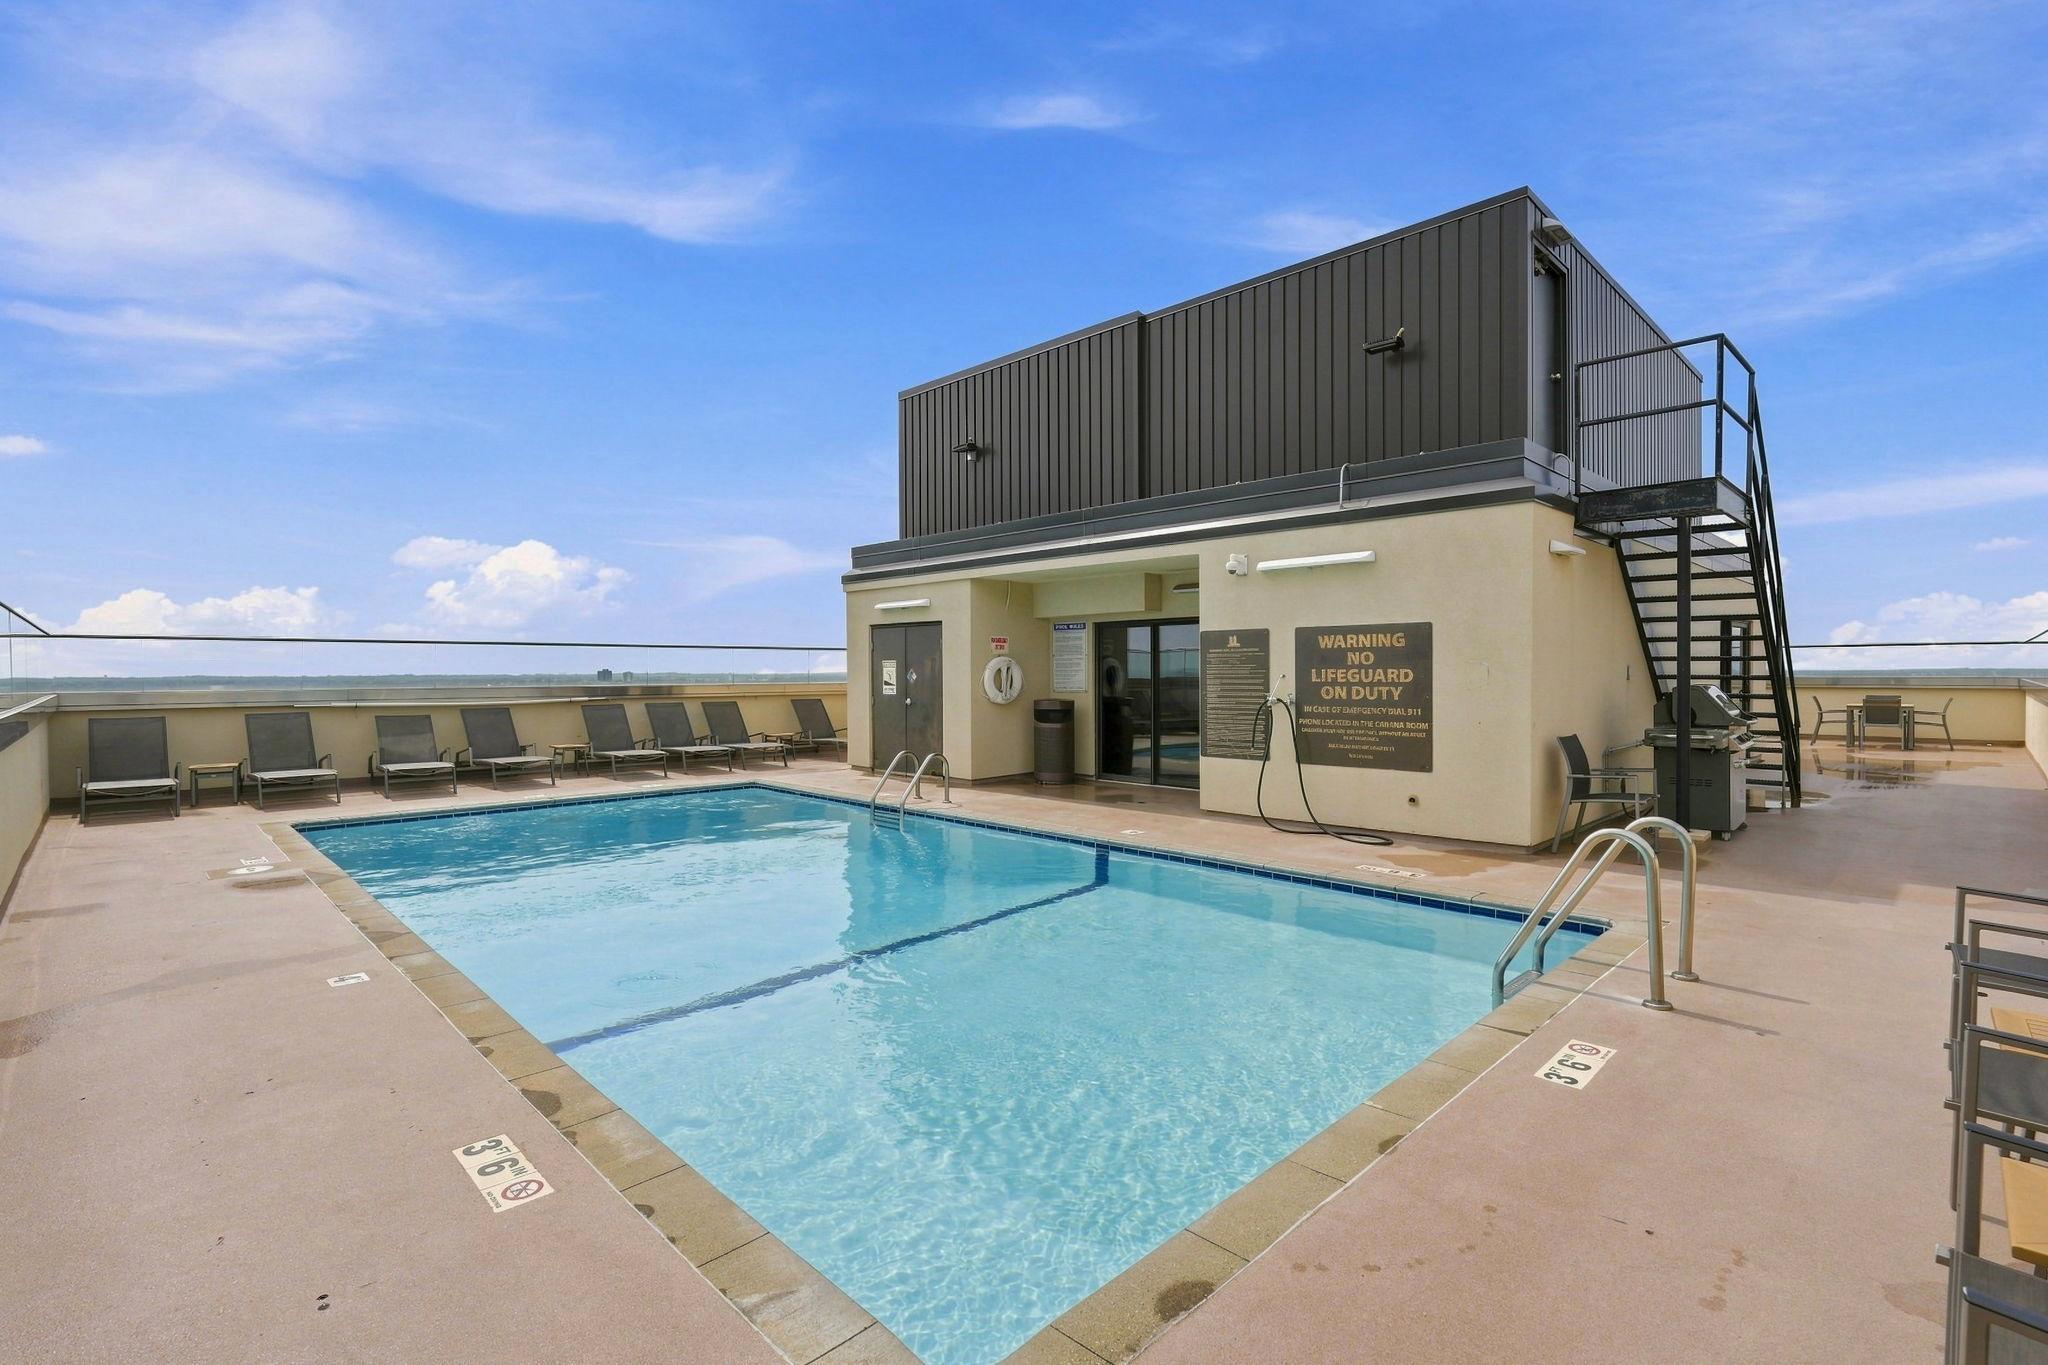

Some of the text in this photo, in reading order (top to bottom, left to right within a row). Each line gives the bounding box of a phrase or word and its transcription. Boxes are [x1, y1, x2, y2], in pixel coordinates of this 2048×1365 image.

[1318, 632, 1406, 649] WARNING
[1347, 651, 1375, 665] NO
[1311, 668, 1414, 683] LIFEGUARD
[1320, 686, 1403, 701] ON DUTY
[1304, 705, 1312, 713] IN
[1313, 705, 1331, 713] CASE
[1342, 706, 1387, 715] EMERGENCY
[1388, 708, 1406, 716] DIAL
[1407, 708, 1422, 716] 911
[1361, 720, 1374, 728] THE
[1557, 1058, 1592, 1071] 6
[1543, 1072, 1579, 1085] 3
[462, 1138, 528, 1177] 3 FT 6 IN
